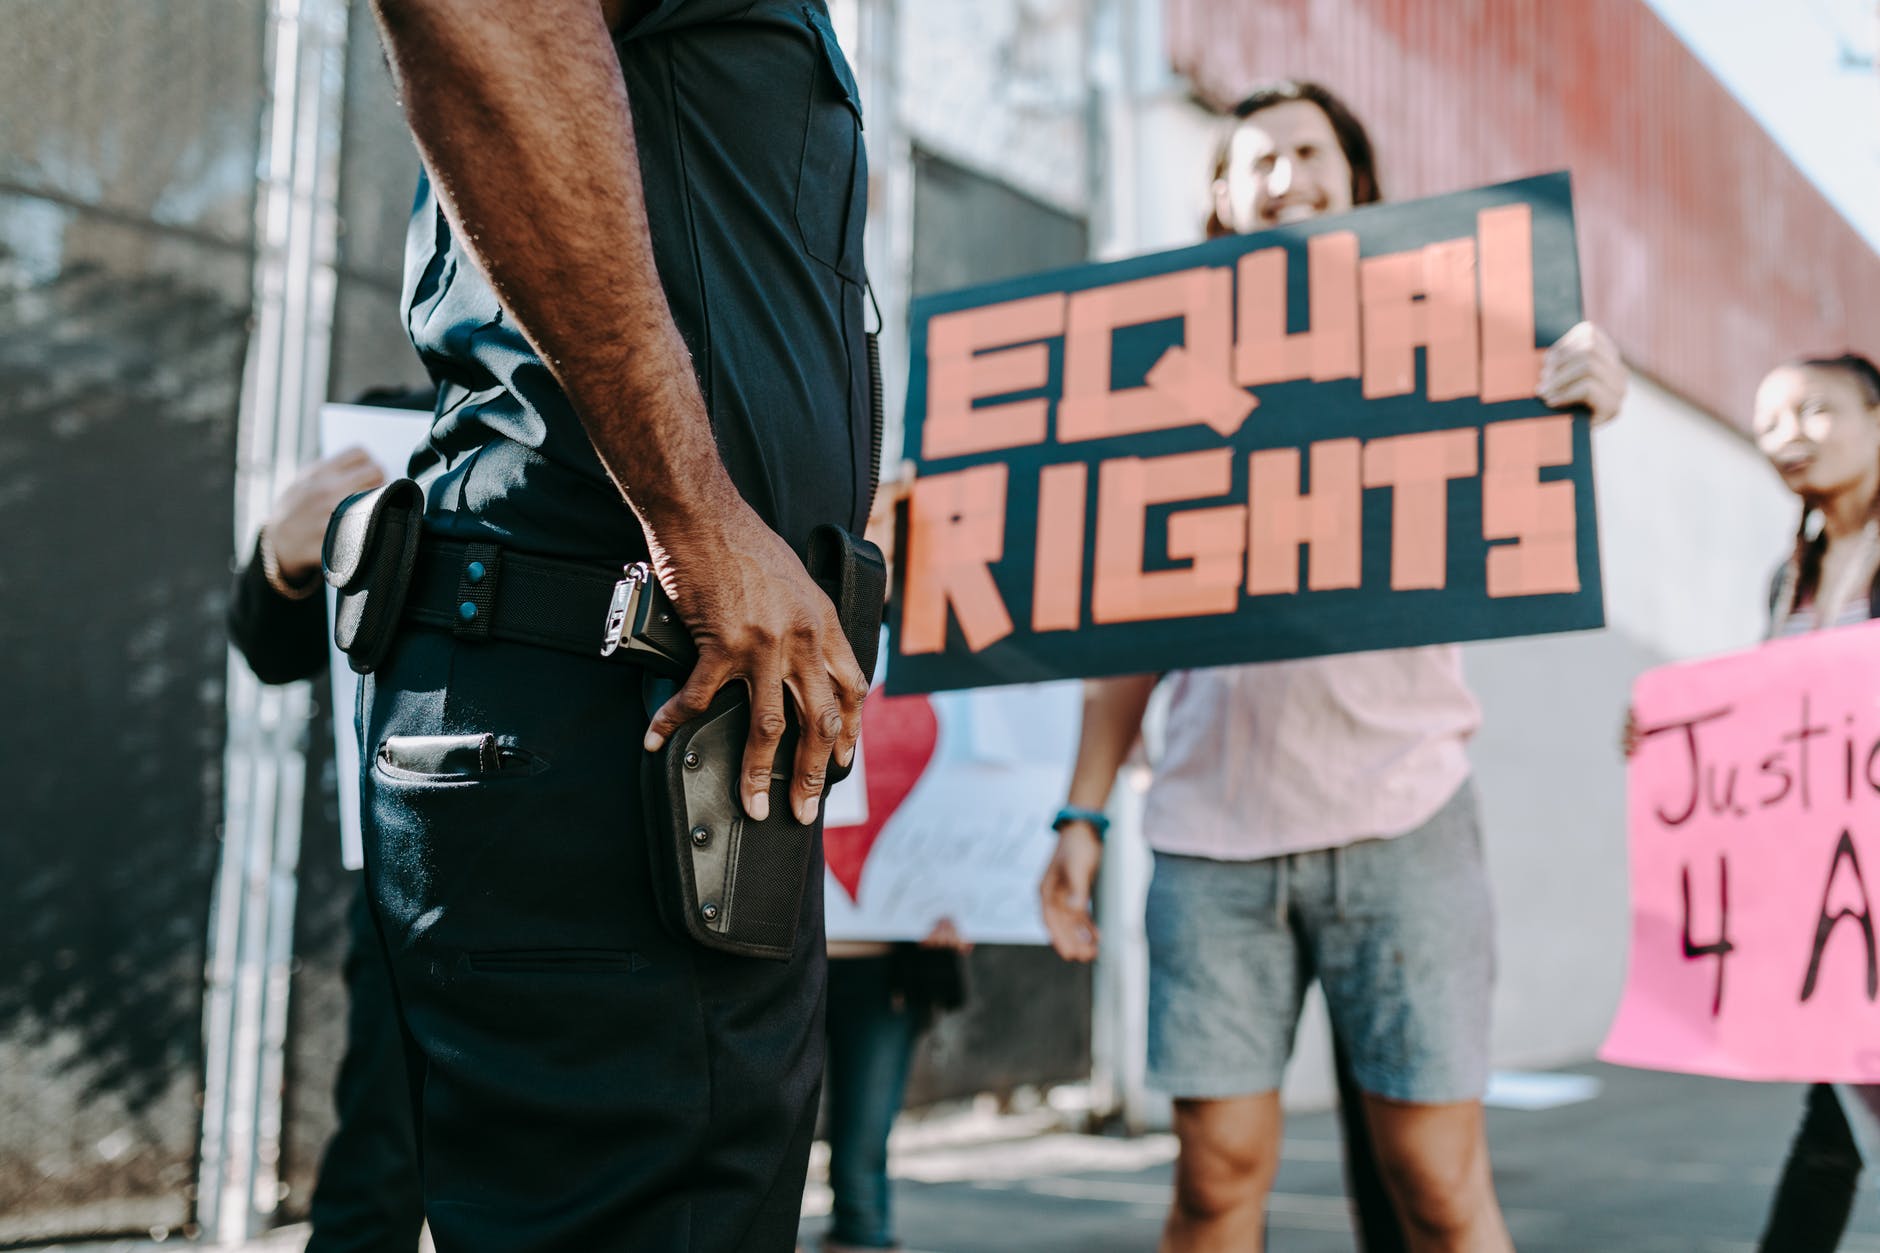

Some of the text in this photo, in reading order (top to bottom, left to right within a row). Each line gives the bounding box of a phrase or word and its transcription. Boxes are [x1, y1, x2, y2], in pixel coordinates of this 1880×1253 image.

[922, 203, 1546, 437] EQUAL
[901, 413, 1581, 655] RIGHTS
[1681, 856, 1735, 1017] 4
